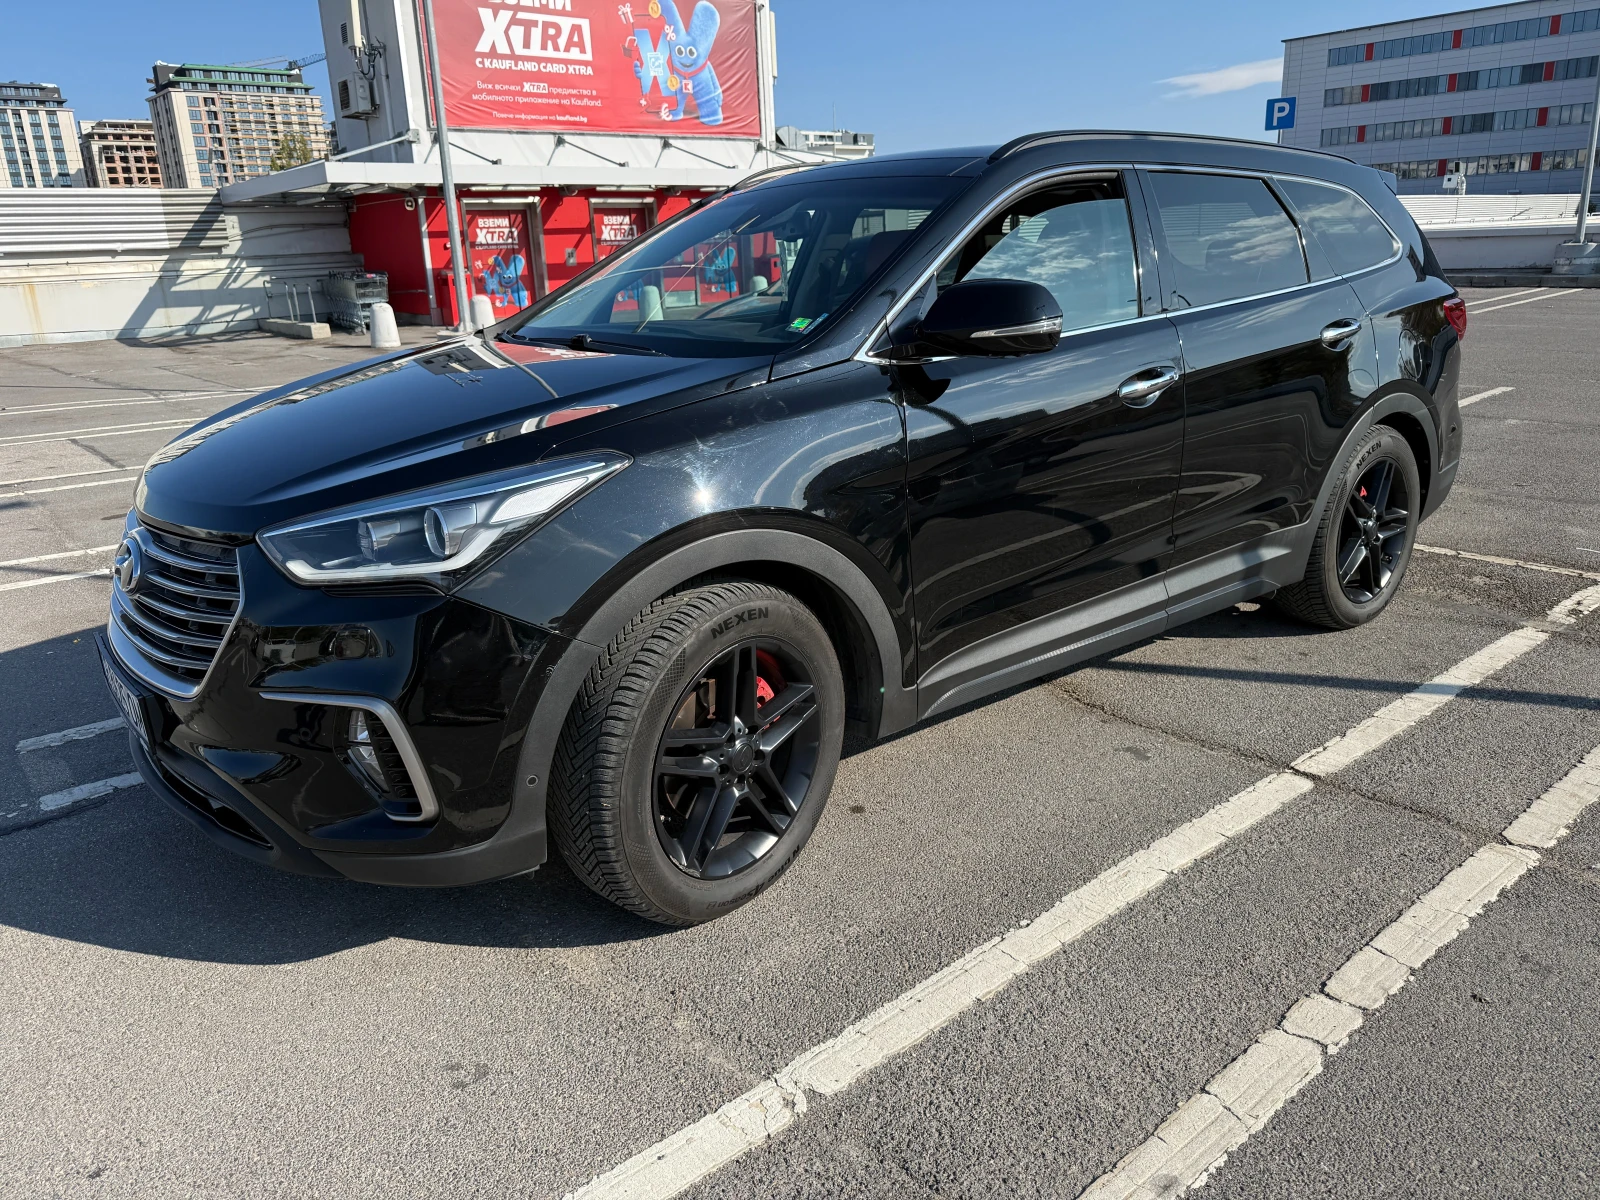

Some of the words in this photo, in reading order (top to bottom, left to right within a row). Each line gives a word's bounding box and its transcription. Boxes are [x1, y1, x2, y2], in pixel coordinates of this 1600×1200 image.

[475, 7, 592, 61] XTRA
[484, 58, 539, 72] KAUFLAND
[540, 62, 566, 74] CARD
[568, 65, 594, 76] XTRA
[476, 80, 493, 90] Виж
[494, 83, 521, 91] всички
[522, 81, 549, 94] XTRA
[549, 87, 591, 96] предимства
[472, 92, 514, 102] мобилното
[515, 96, 560, 105] приложение
[571, 97, 603, 107] Kaufland.
[492, 111, 515, 119] Повече
[555, 114, 588, 123] kaufland.bg
[1272, 101, 1290, 127] P
[478, 218, 509, 227] ВЗЕМИ
[603, 216, 630, 224] ВЗЕМИ
[475, 228, 518, 244] XTRA
[601, 225, 637, 240] XTRA
[1356, 441, 1382, 469] NEXEN
[710, 606, 770, 639] NEXEN
